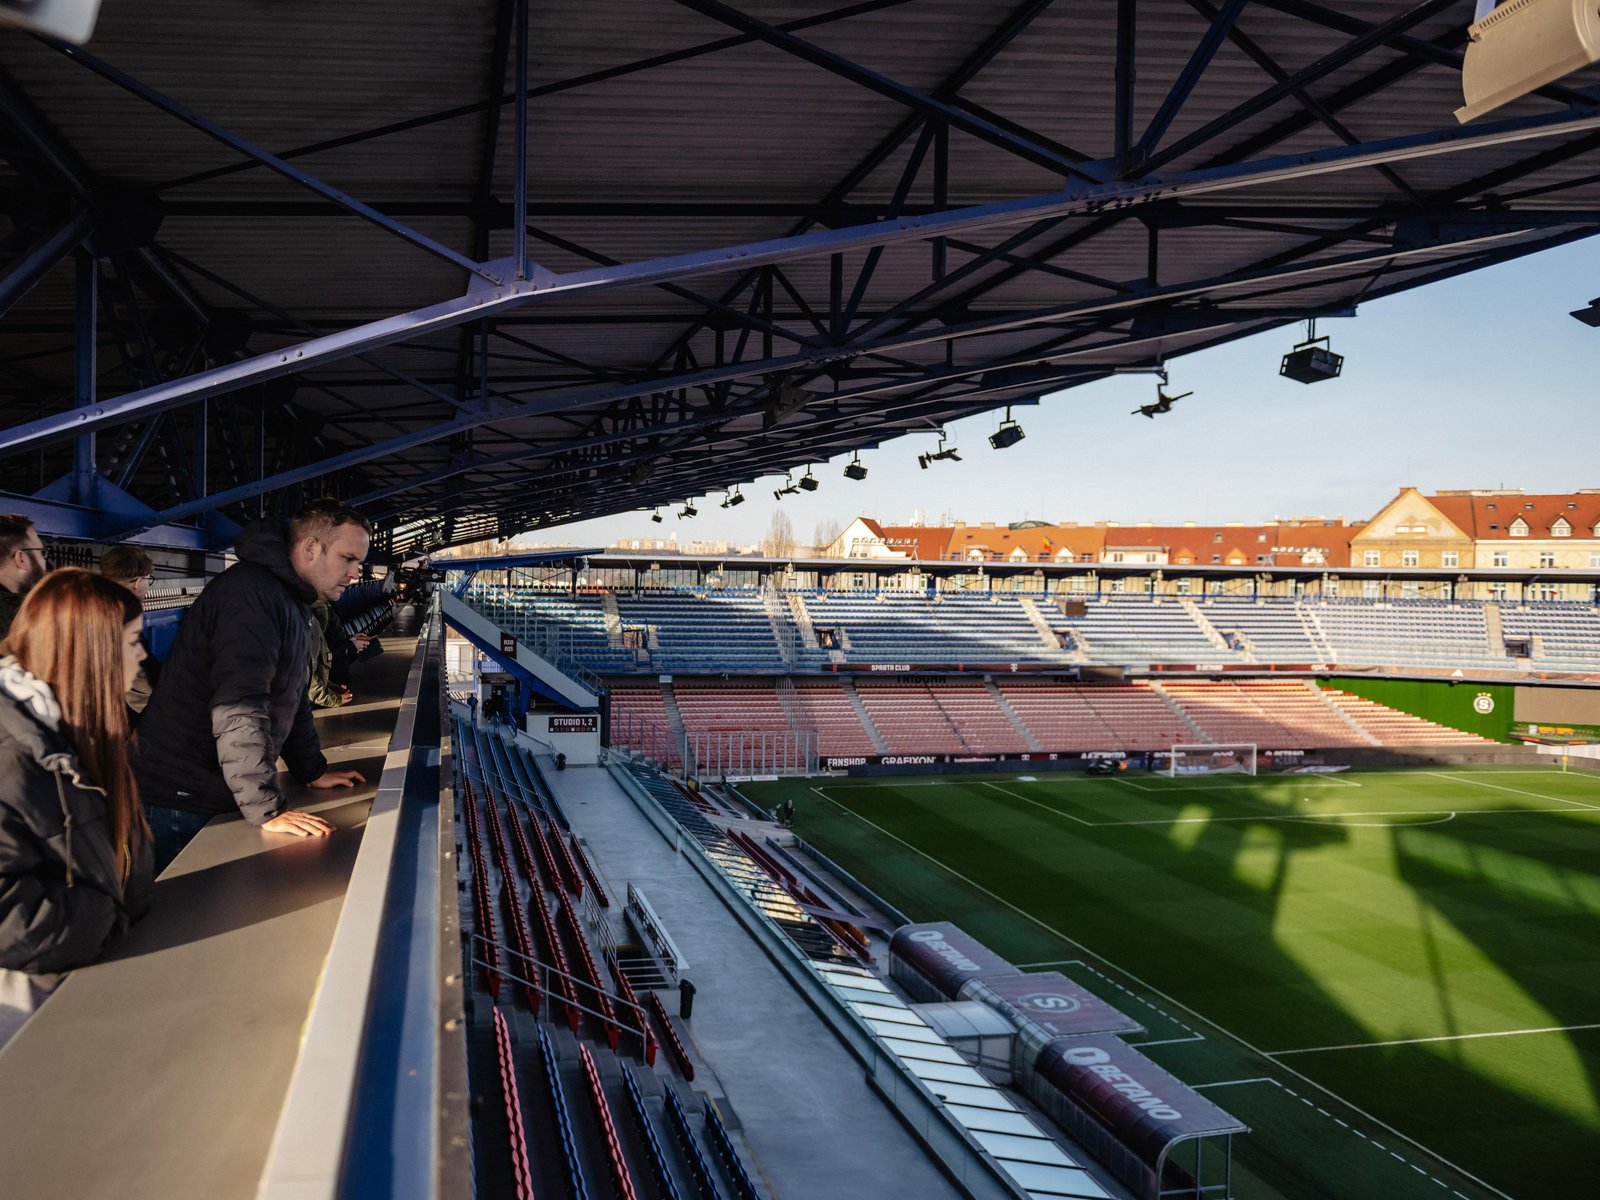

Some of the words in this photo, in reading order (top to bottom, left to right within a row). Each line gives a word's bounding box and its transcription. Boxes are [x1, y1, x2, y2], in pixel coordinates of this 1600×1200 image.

[553, 718, 580, 726] STUDIO
[587, 718, 593, 726] 2
[881, 756, 934, 765] GRAFIXON
